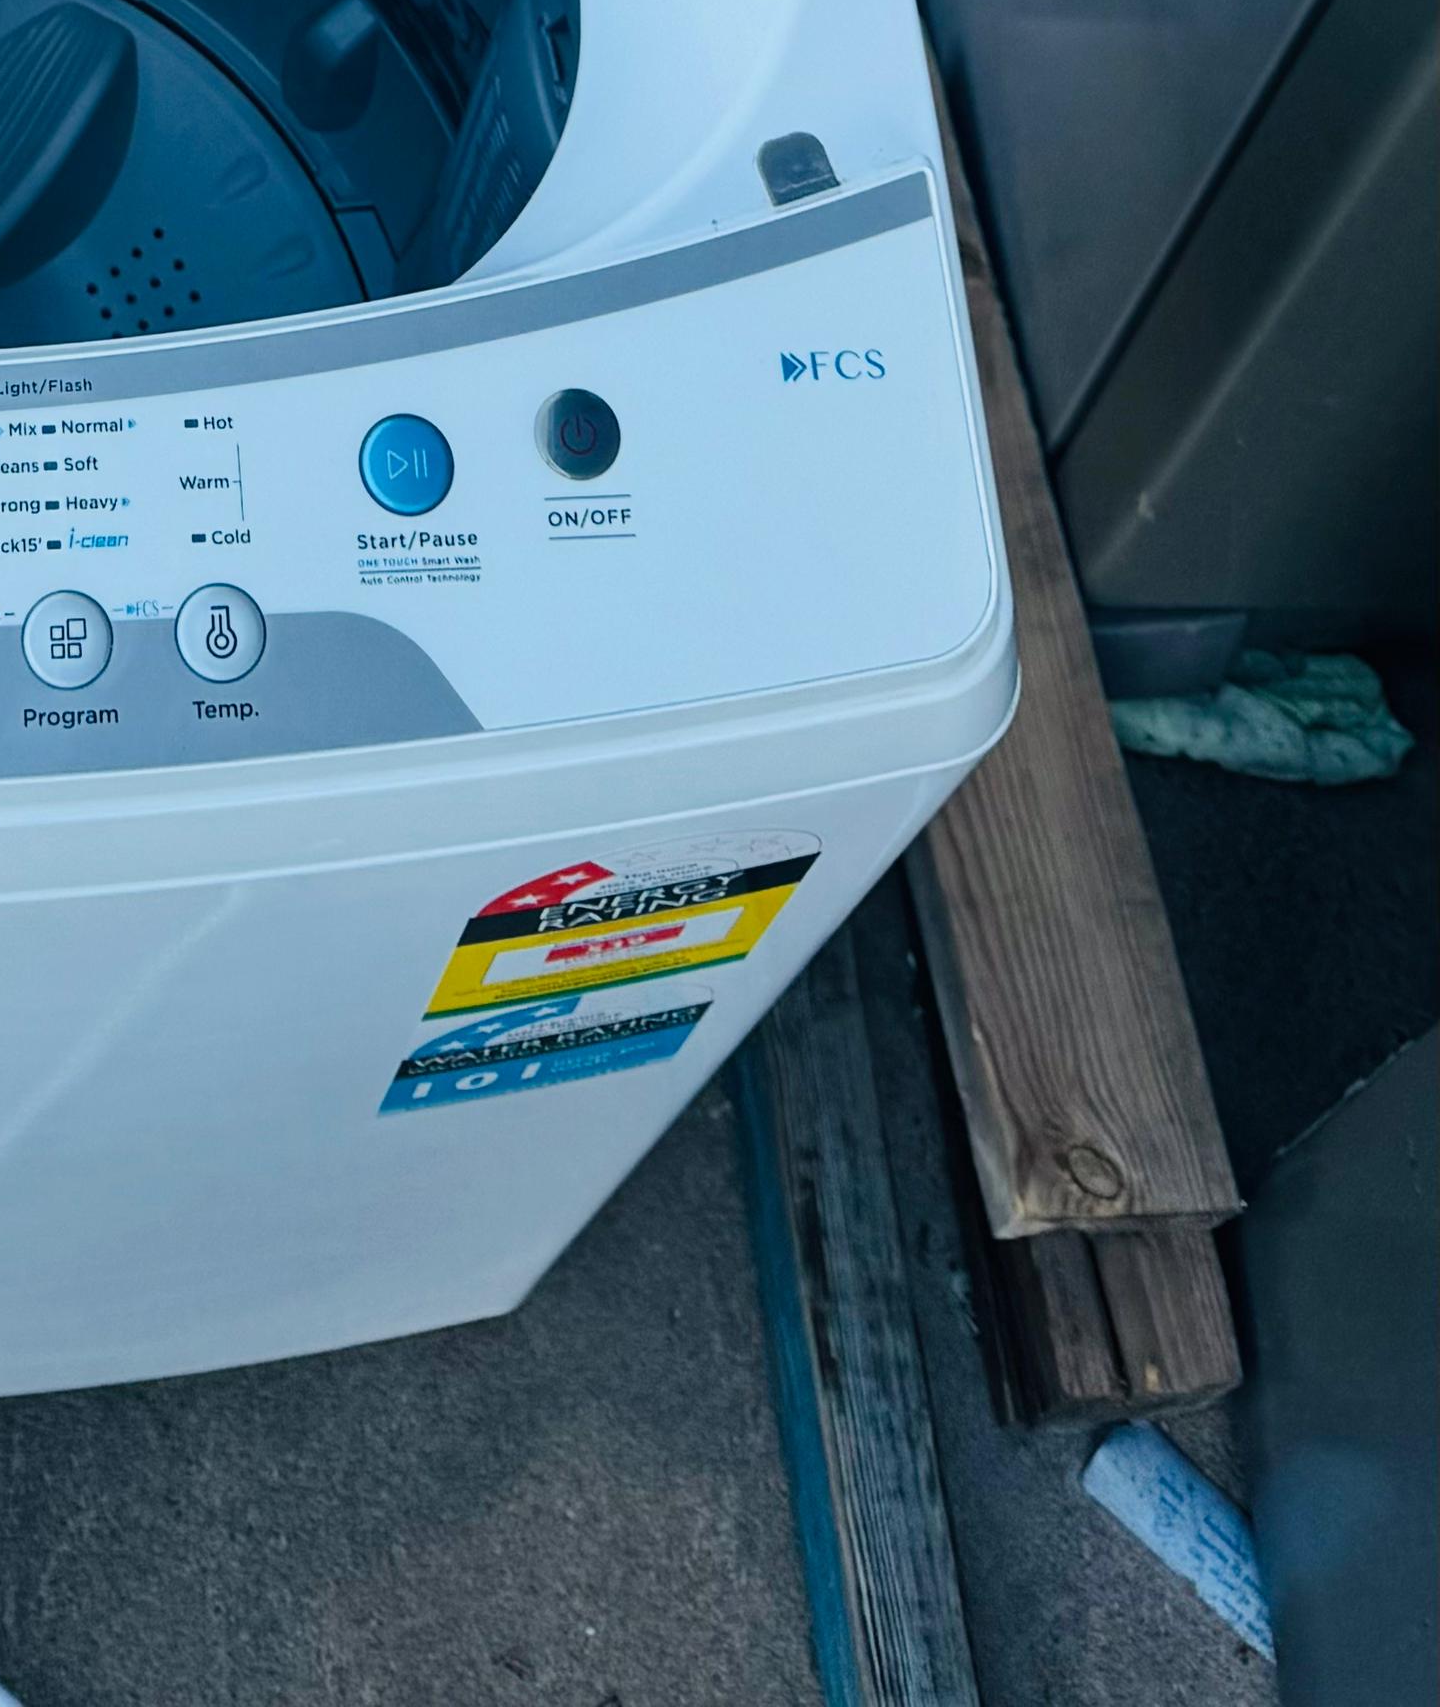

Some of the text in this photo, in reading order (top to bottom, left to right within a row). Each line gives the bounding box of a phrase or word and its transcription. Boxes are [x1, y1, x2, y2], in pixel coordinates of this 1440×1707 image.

[810, 349, 886, 381] FCS
[8, 422, 37, 437] Mix
[61, 417, 123, 434] Normal
[203, 416, 233, 430] Hot
[64, 455, 99, 472] Soft
[179, 475, 230, 490] Warm
[66, 496, 118, 512] Heavy
[548, 508, 631, 528] ON/OFF
[211, 528, 251, 545] Cold
[357, 531, 478, 550] Start/Pause
[358, 555, 481, 568] ONE TOUCH Smart Wash
[360, 572, 481, 585] Auto Control Technology
[135, 600, 160, 617] FCS
[23, 708, 119, 730] Program
[192, 700, 259, 721] Temp.
[540, 871, 745, 920] ENERGY
[537, 888, 728, 932] RATING
